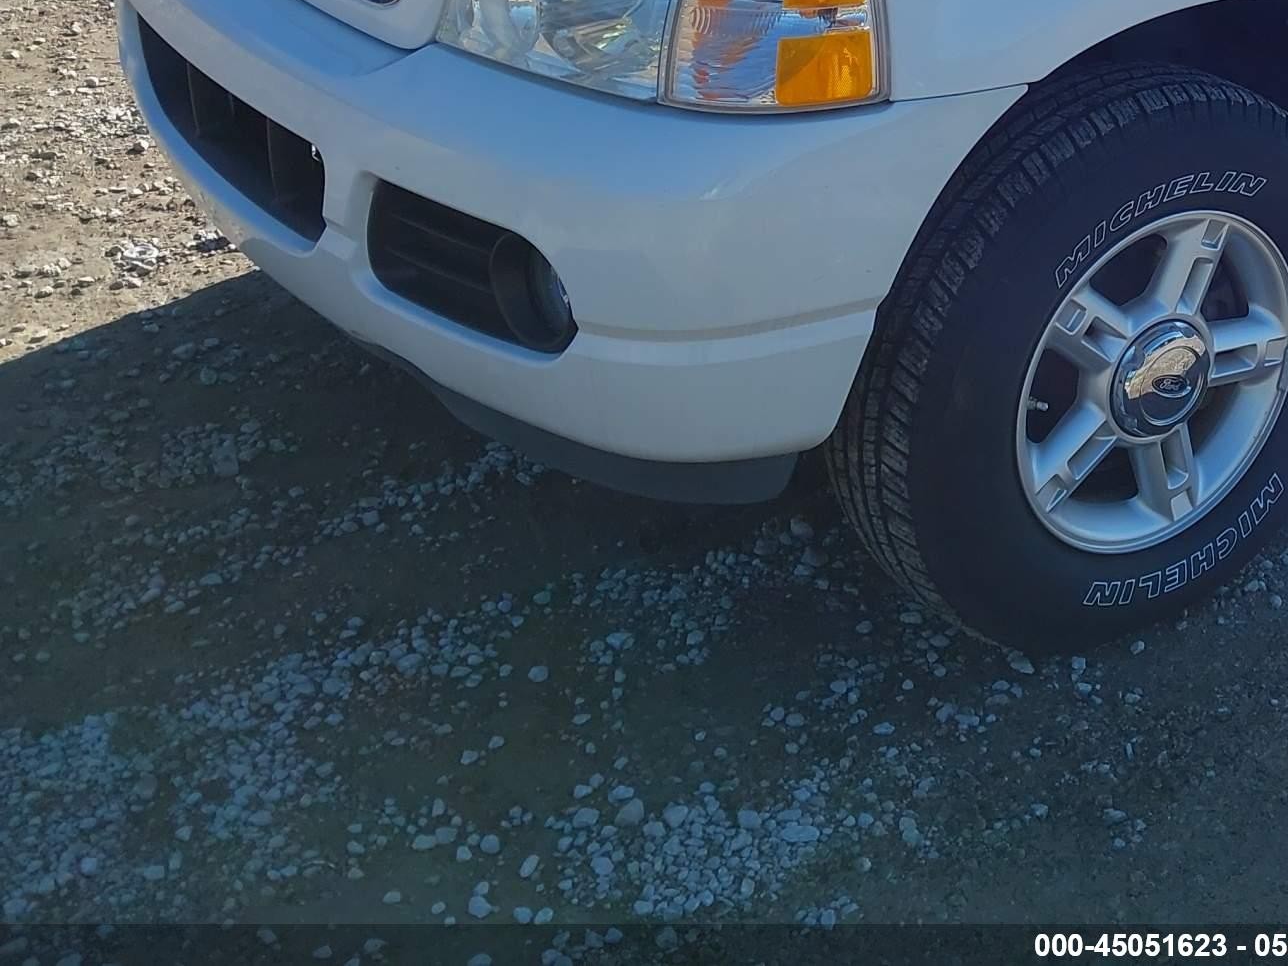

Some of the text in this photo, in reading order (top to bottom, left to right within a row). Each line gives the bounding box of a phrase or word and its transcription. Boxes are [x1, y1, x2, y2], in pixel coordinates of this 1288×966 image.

[1055, 171, 1268, 289] MICHELIN
[1159, 378, 1181, 391] Ford
[1082, 472, 1285, 607] MICHELIN
